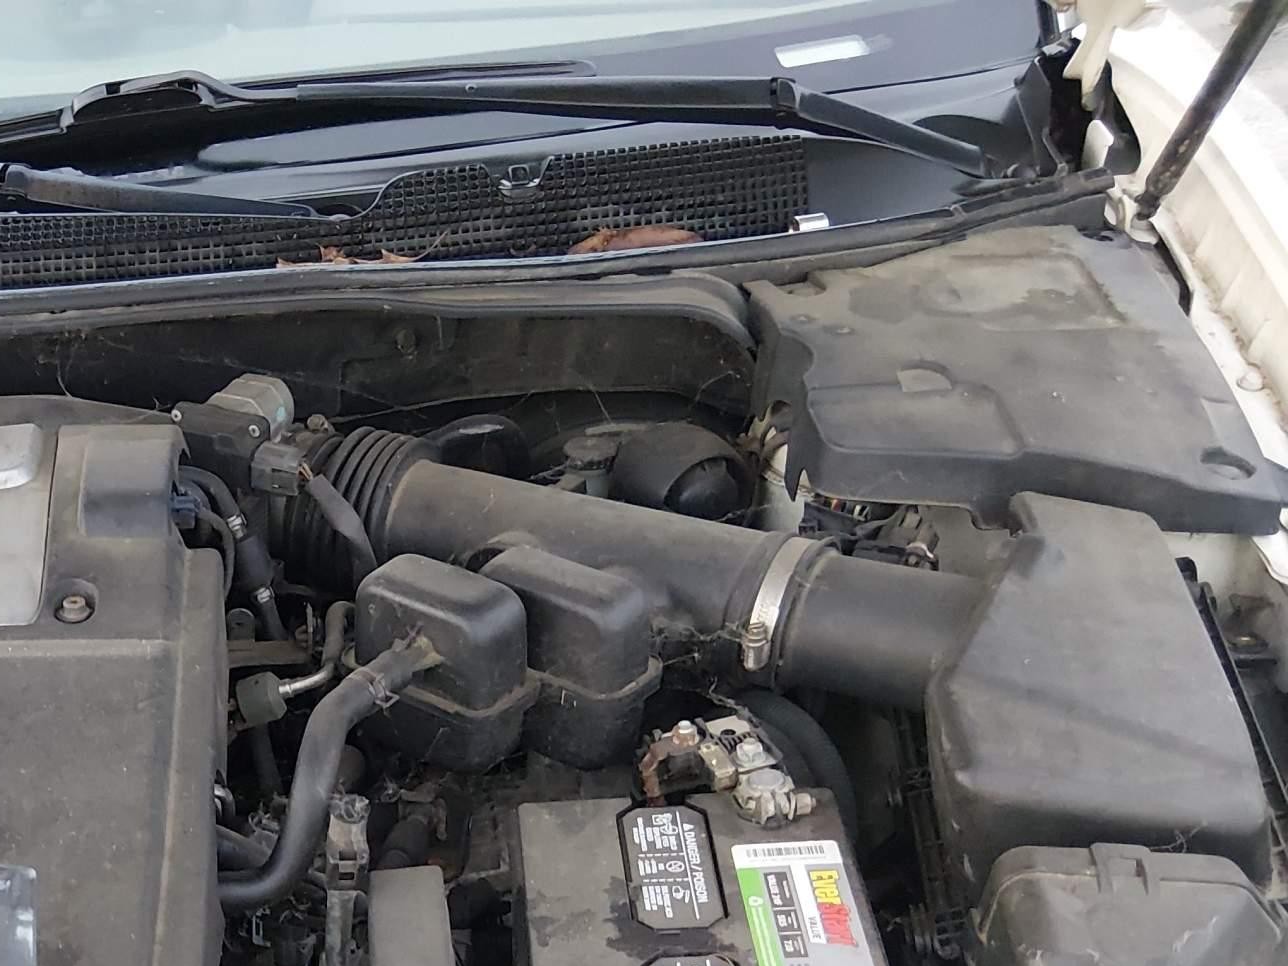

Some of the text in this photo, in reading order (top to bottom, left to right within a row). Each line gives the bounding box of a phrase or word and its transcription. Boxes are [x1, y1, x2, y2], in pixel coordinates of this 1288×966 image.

[684, 831, 701, 865] DANGER
[693, 871, 709, 903] POISON
[808, 916, 822, 940] VALUE
[809, 870, 857, 947] EverStart
